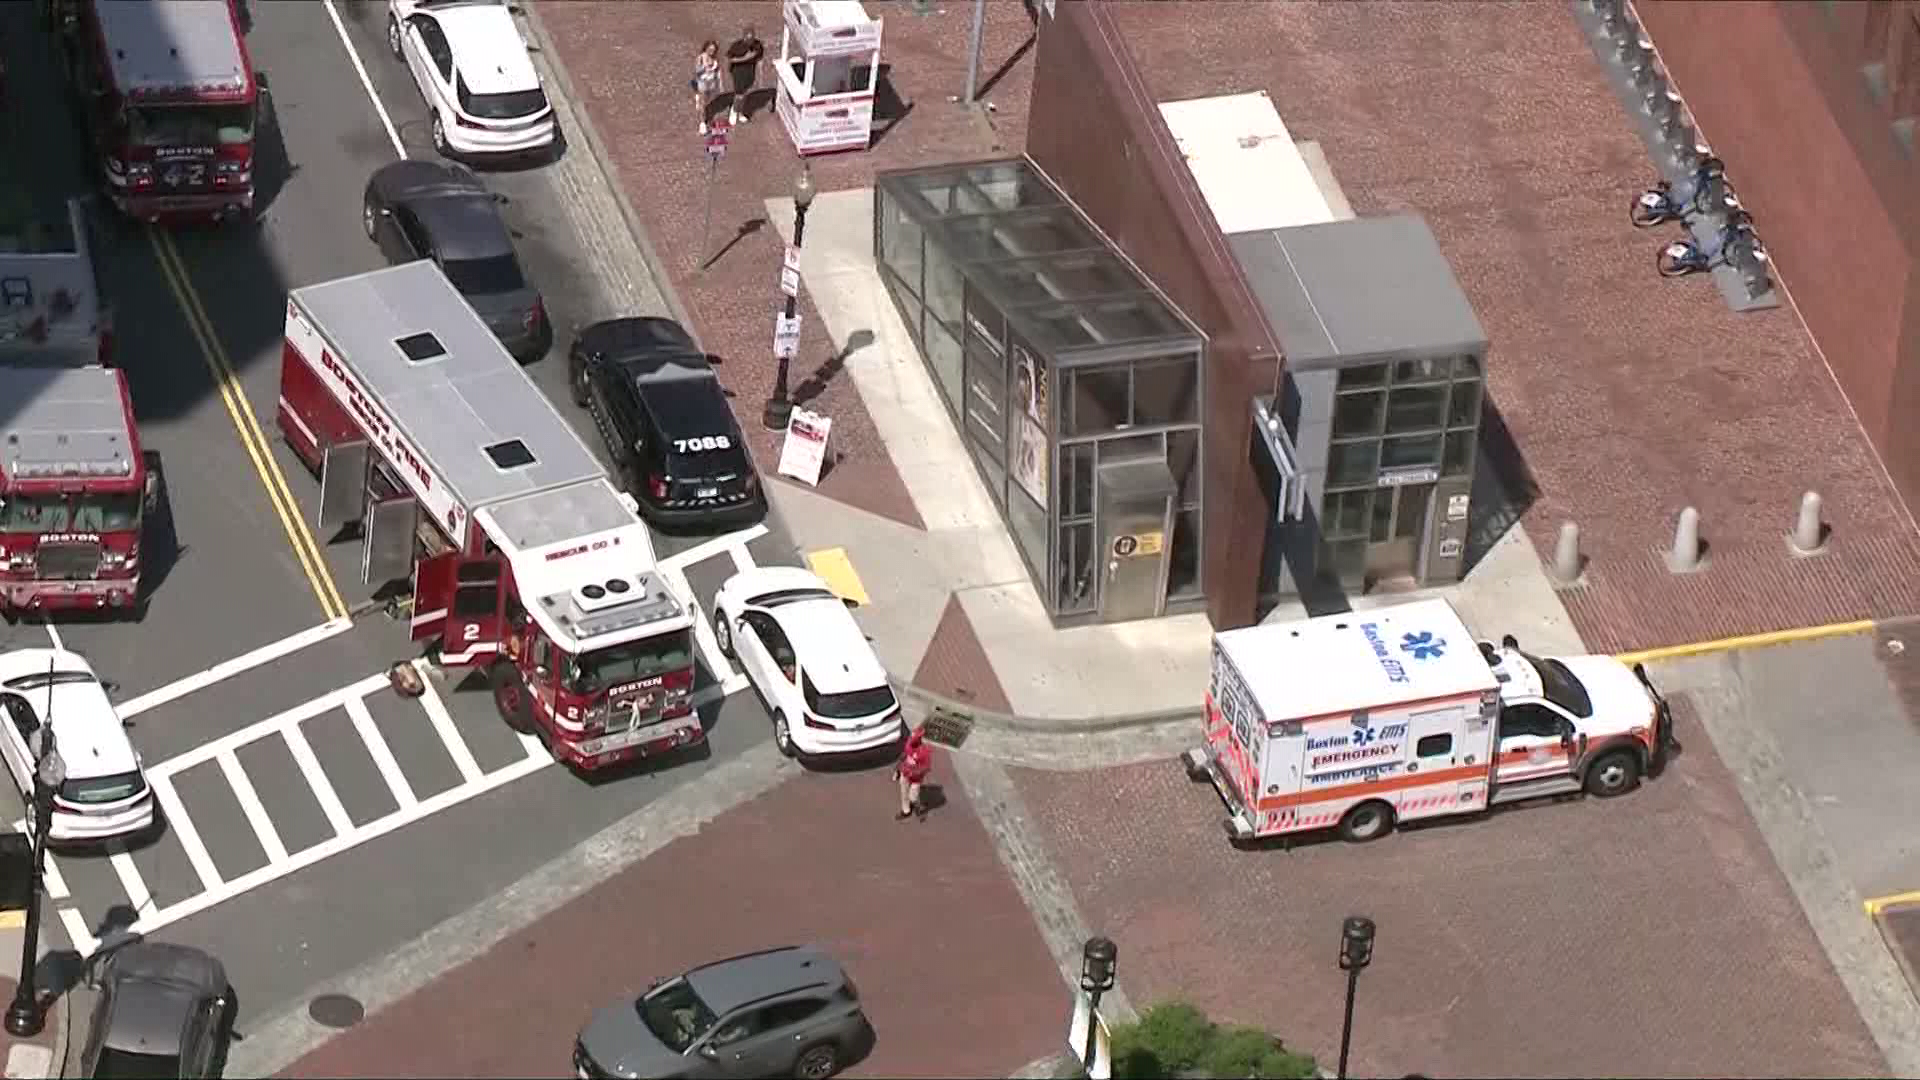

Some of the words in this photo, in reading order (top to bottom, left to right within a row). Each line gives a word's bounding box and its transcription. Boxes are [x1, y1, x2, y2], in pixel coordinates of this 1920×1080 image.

[321, 348, 390, 434] BOSTON
[395, 436, 431, 490] FIRE
[40, 533, 100, 543] BOSTON
[463, 624, 480, 640] 2
[1360, 622, 1389, 657] Boston
[608, 676, 663, 697] BOSTON
[567, 706, 579, 719] 2
[1306, 734, 1348, 751] Boston
[1378, 722, 1408, 740] EMS
[1311, 743, 1400, 767] EMERGENCY
[1310, 762, 1398, 784] AMBULANCE
